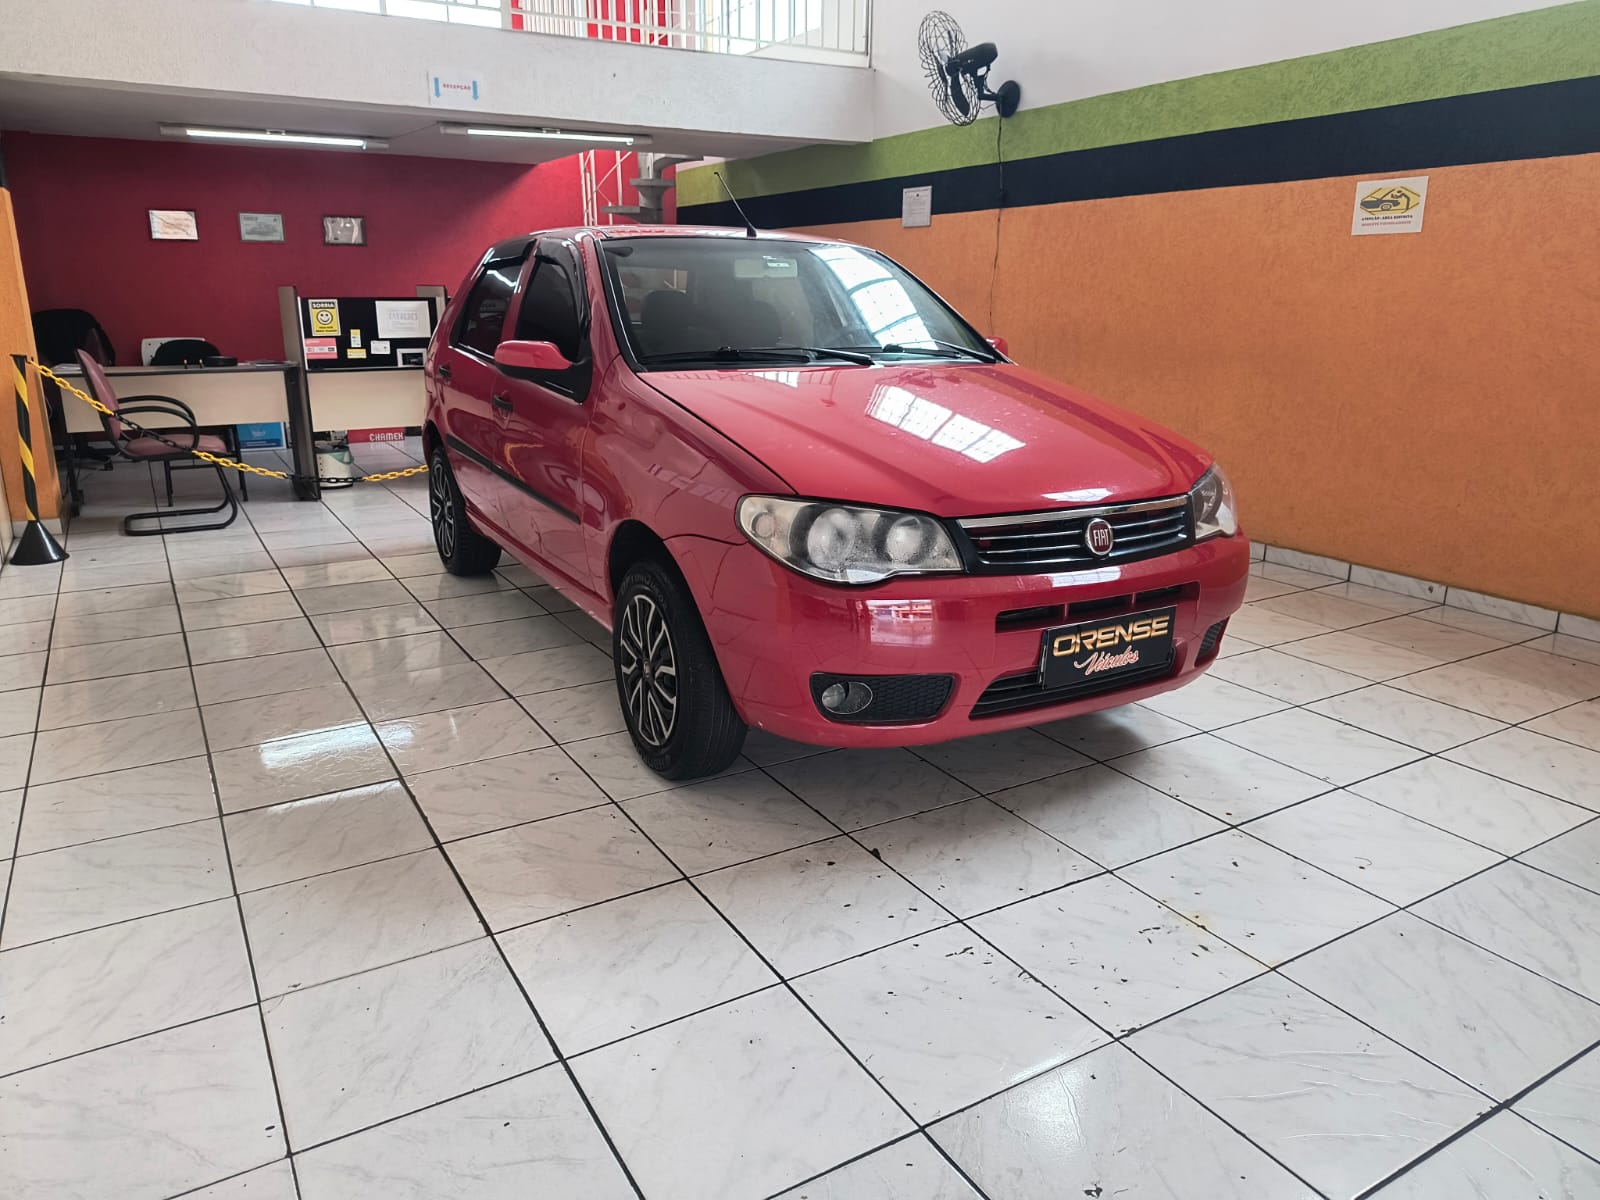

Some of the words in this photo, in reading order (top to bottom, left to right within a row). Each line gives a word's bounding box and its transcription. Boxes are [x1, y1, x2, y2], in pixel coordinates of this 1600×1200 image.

[369, 431, 404, 441] CHAMEX
[1093, 528, 1109, 547] FIAT
[1052, 615, 1170, 657] ORENSE
